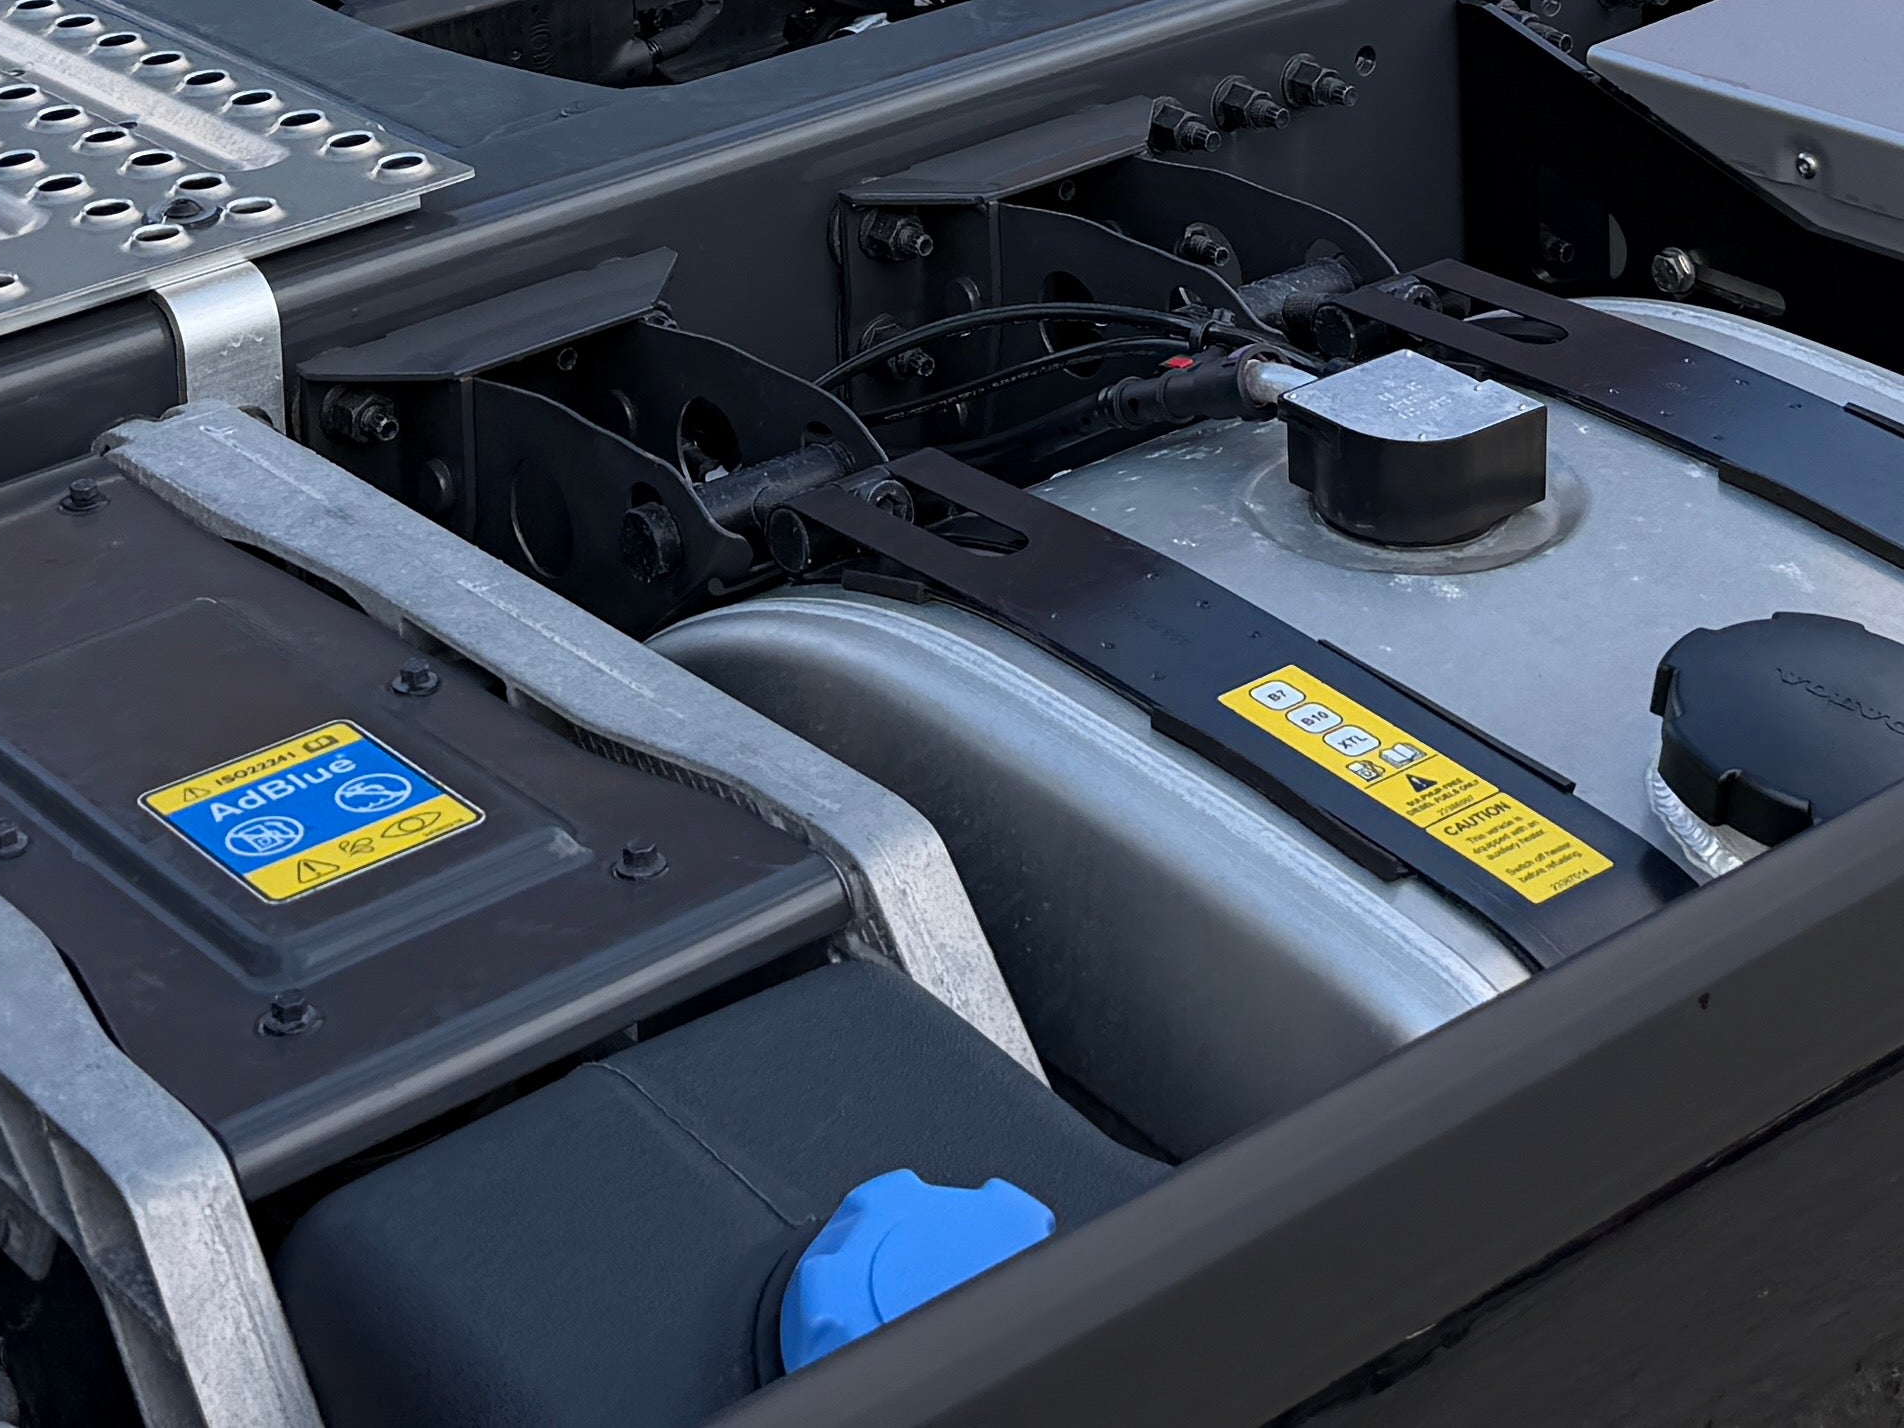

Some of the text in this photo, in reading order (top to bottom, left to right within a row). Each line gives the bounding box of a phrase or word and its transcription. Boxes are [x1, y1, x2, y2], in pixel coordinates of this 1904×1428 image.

[1267, 689, 1287, 702] B7
[1300, 711, 1329, 727] B10
[1338, 735, 1368, 750] XTL
[215, 751, 296, 787] ISO22241
[1443, 801, 1512, 837] CAUTION
